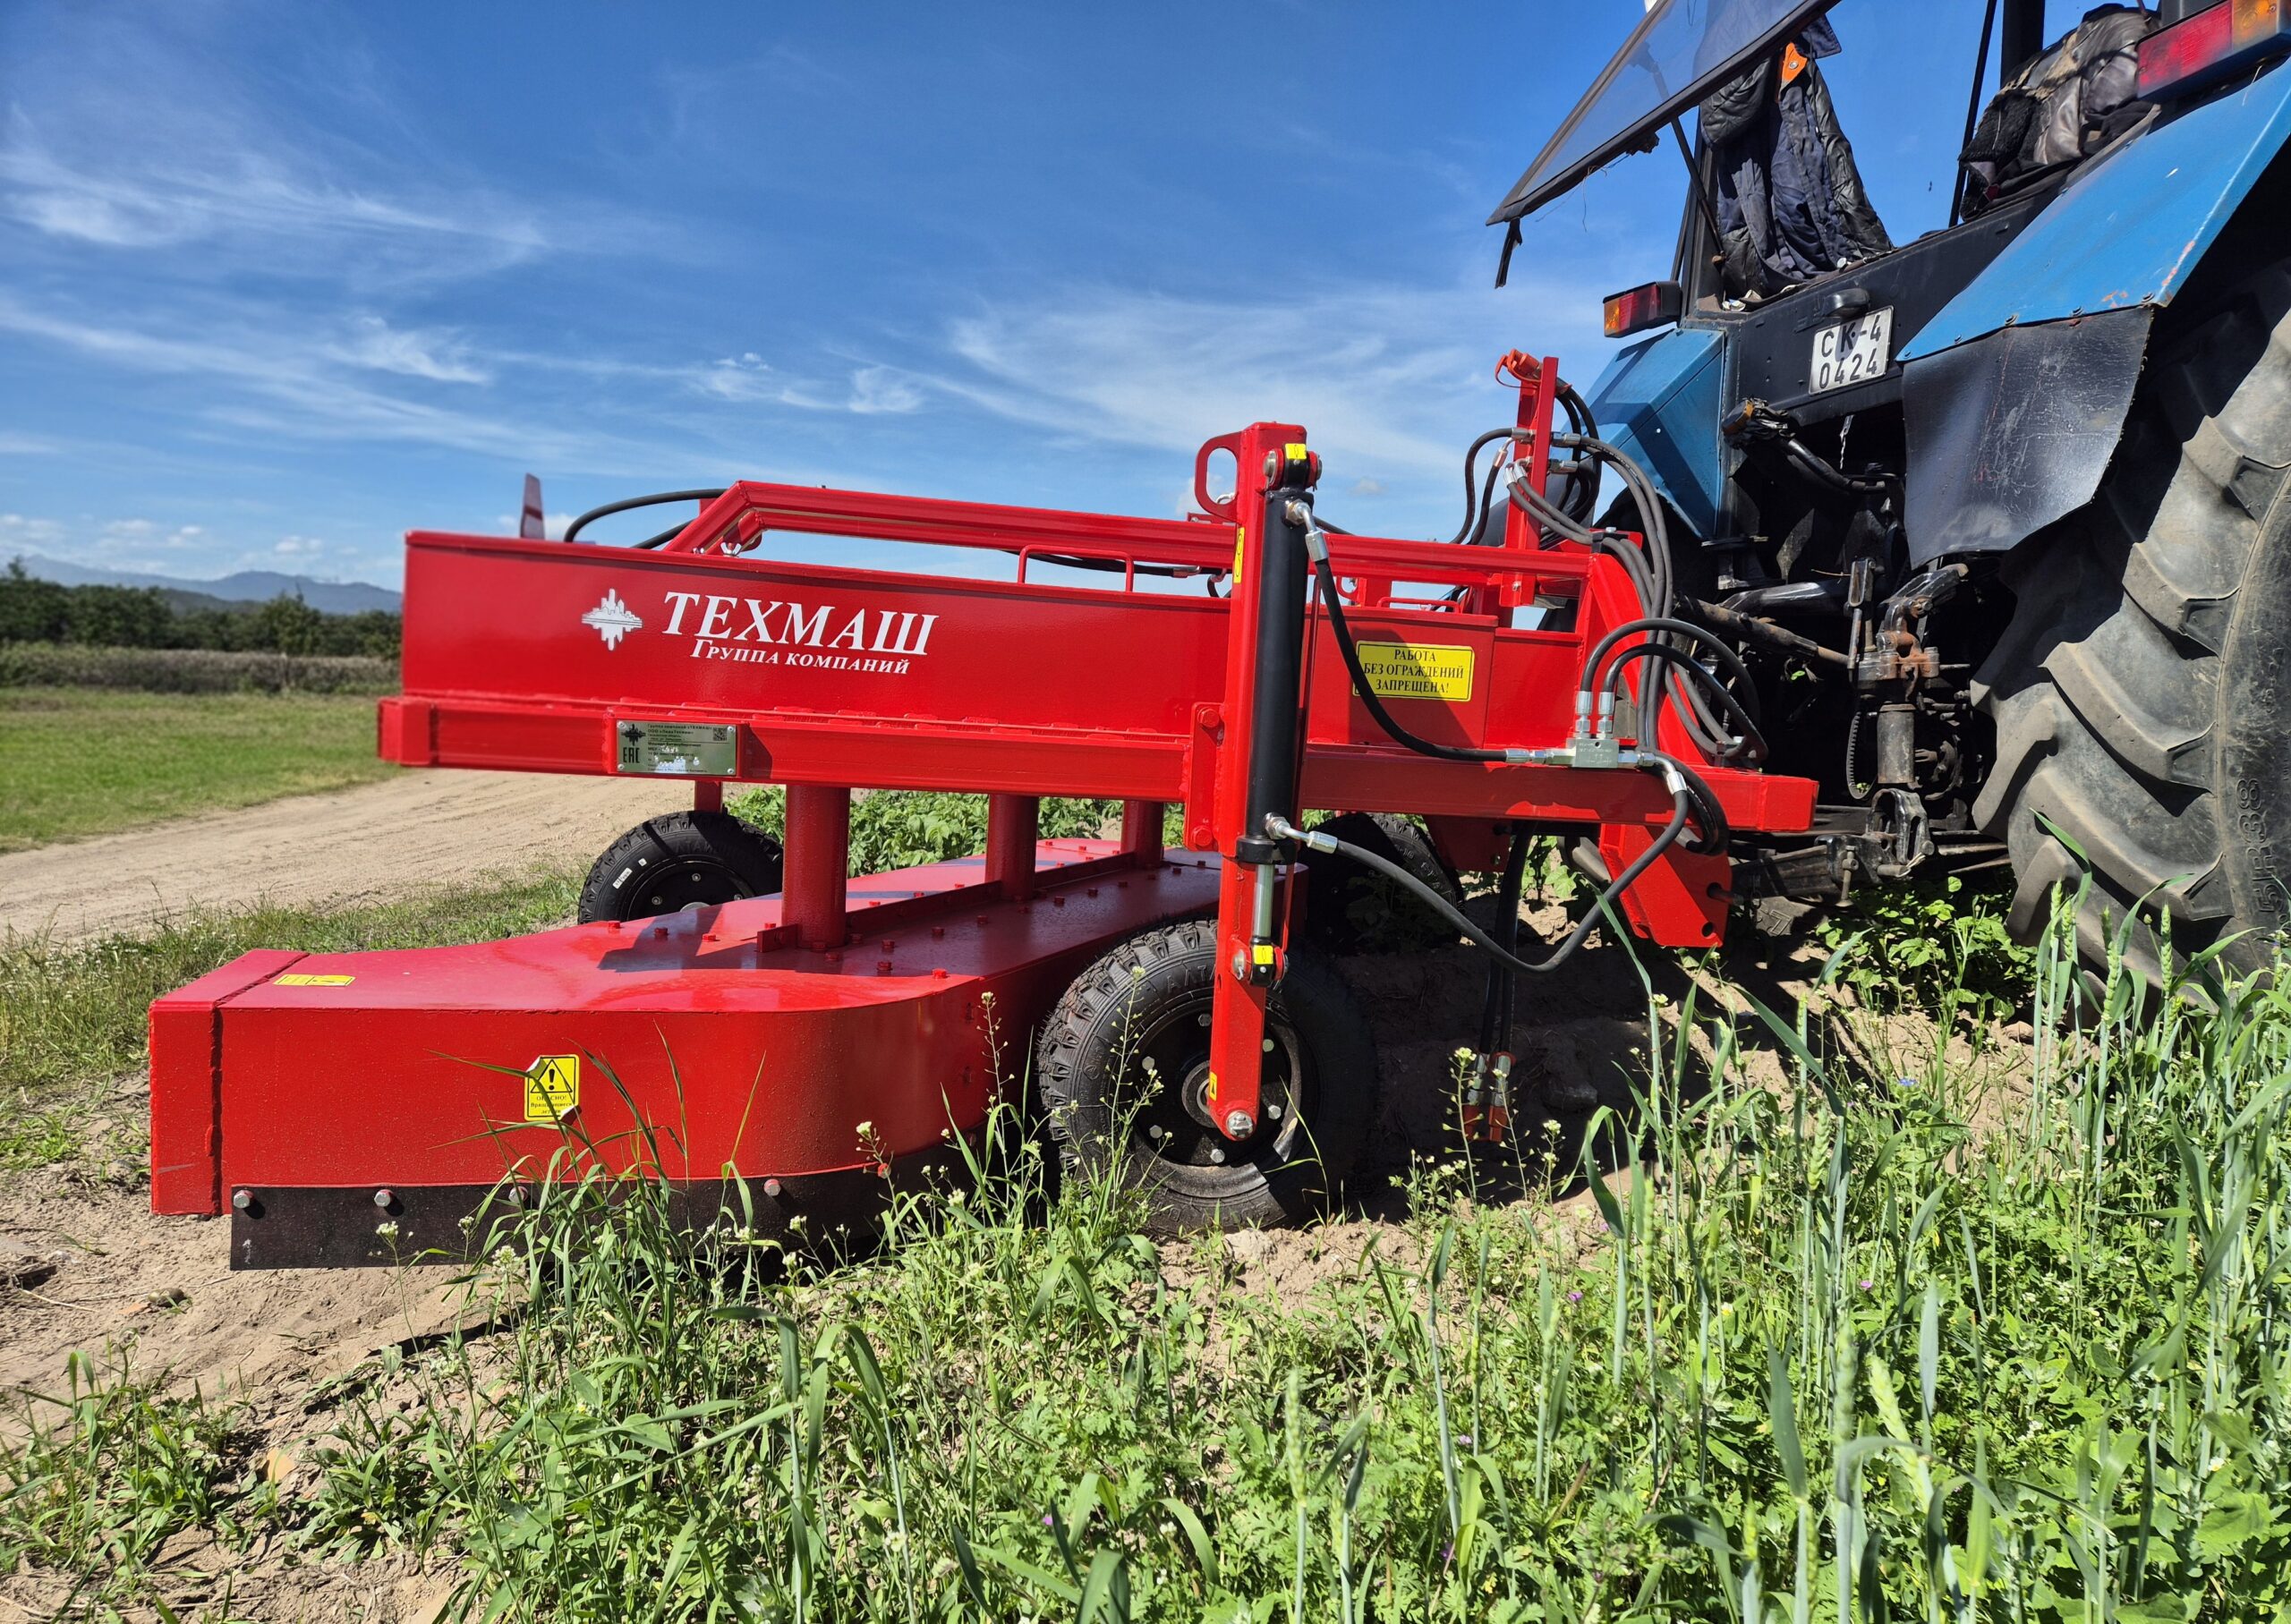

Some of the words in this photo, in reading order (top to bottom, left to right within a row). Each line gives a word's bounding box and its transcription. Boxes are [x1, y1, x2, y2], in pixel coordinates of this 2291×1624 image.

[1819, 348, 1878, 388] 0424
[661, 591, 940, 656] ТЕХМАШ
[1393, 649, 1436, 662] РАБОТА
[1364, 662, 1384, 675] БЕЗ
[1387, 664, 1464, 679] ОГРАЖДЕНИЙ
[1375, 678, 1450, 693] ЗАПРЕЩЕНА!
